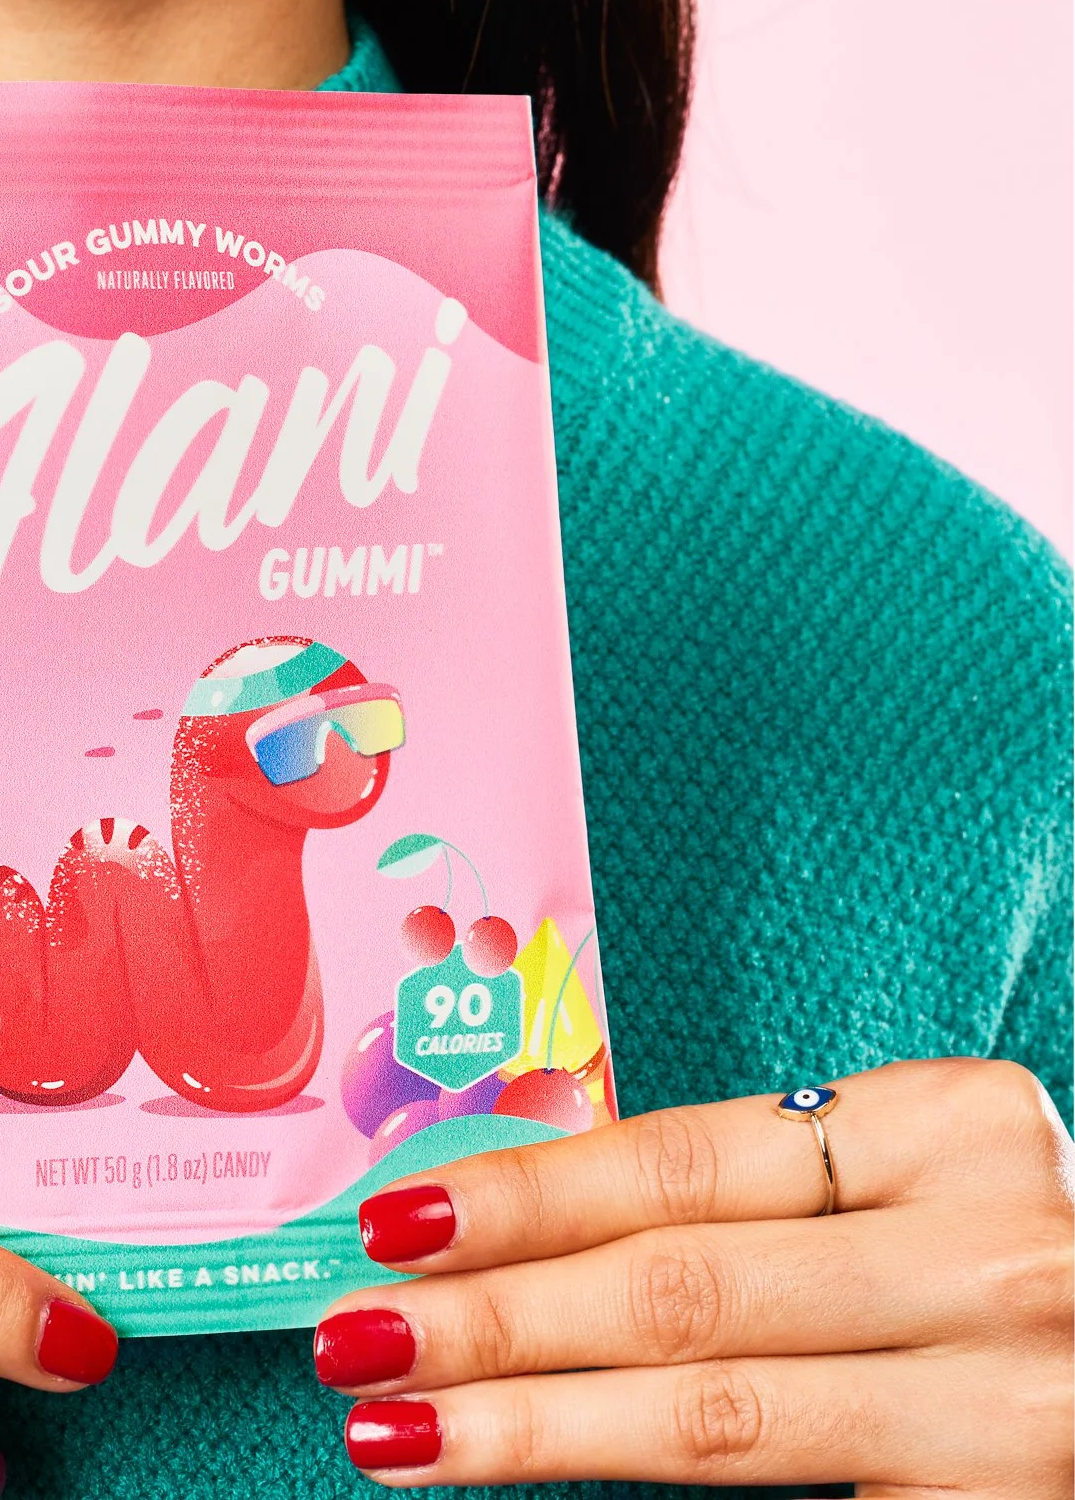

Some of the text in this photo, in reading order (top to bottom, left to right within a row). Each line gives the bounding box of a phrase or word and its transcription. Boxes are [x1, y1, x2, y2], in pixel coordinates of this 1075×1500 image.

[86, 218, 207, 256] GUMMY
[215, 227, 326, 312] WORMS
[97, 271, 235, 290] NATURALLY FLAVORED
[425, 983, 492, 1028] 90
[415, 1031, 505, 1056] CALORIES
[35, 1151, 271, 1189] NET WT 50 g (1.8 oz) CANDY
[119, 1268, 183, 1290] LIKE
[194, 1267, 213, 1287] A
